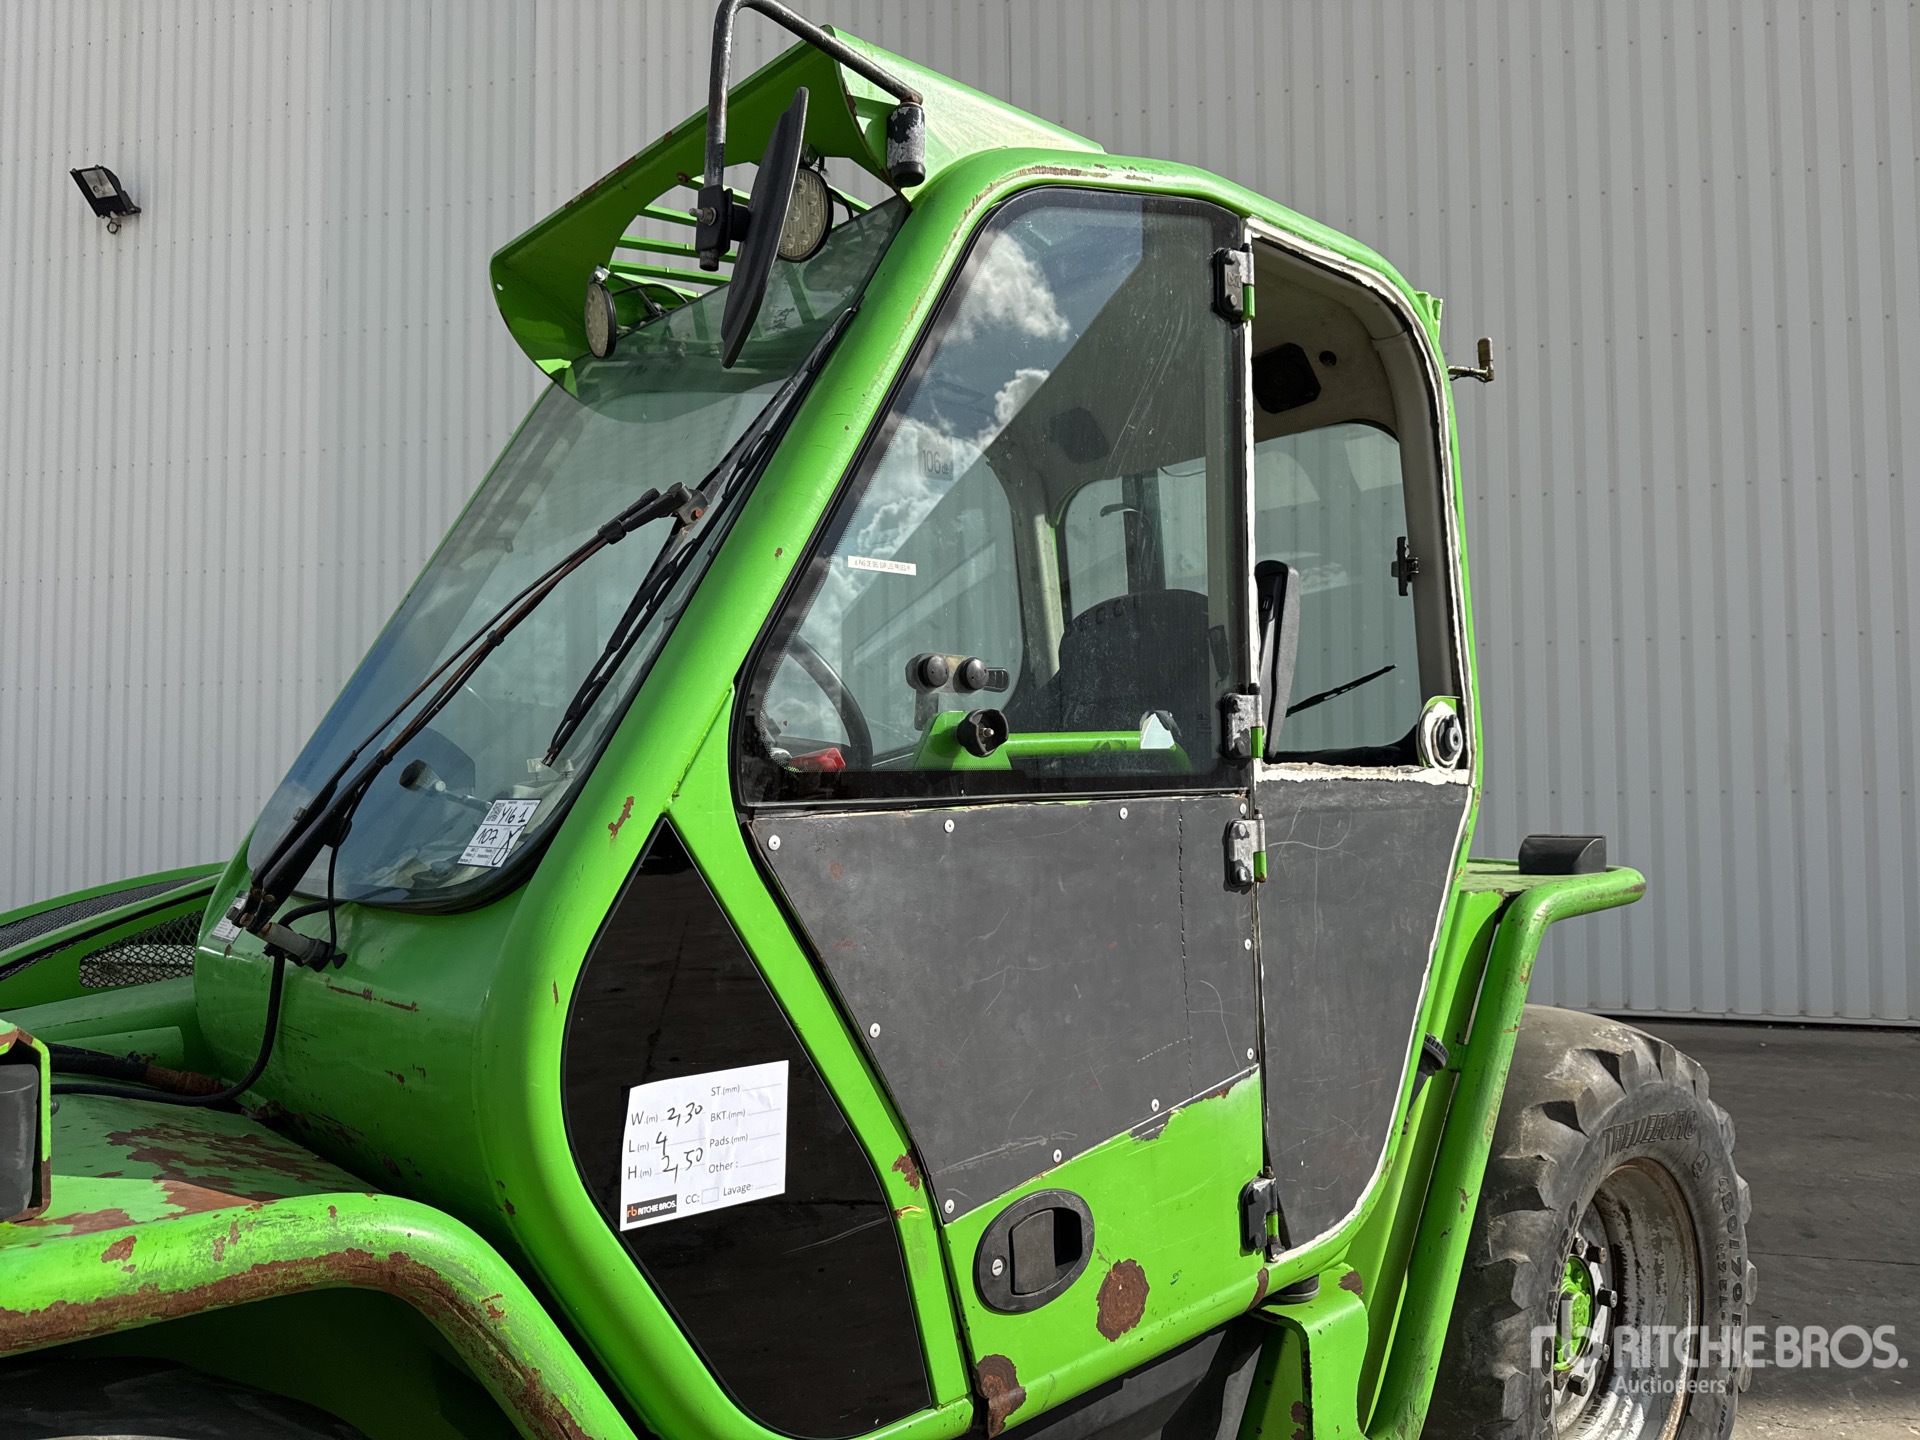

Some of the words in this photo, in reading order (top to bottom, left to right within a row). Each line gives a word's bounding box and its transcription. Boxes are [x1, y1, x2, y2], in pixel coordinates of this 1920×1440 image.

[922, 450, 941, 474] 106
[655, 1131, 668, 1156] 4
[1603, 1109, 1698, 1159] TRELLEBORG
[637, 1204, 659, 1216] RITCHIE
